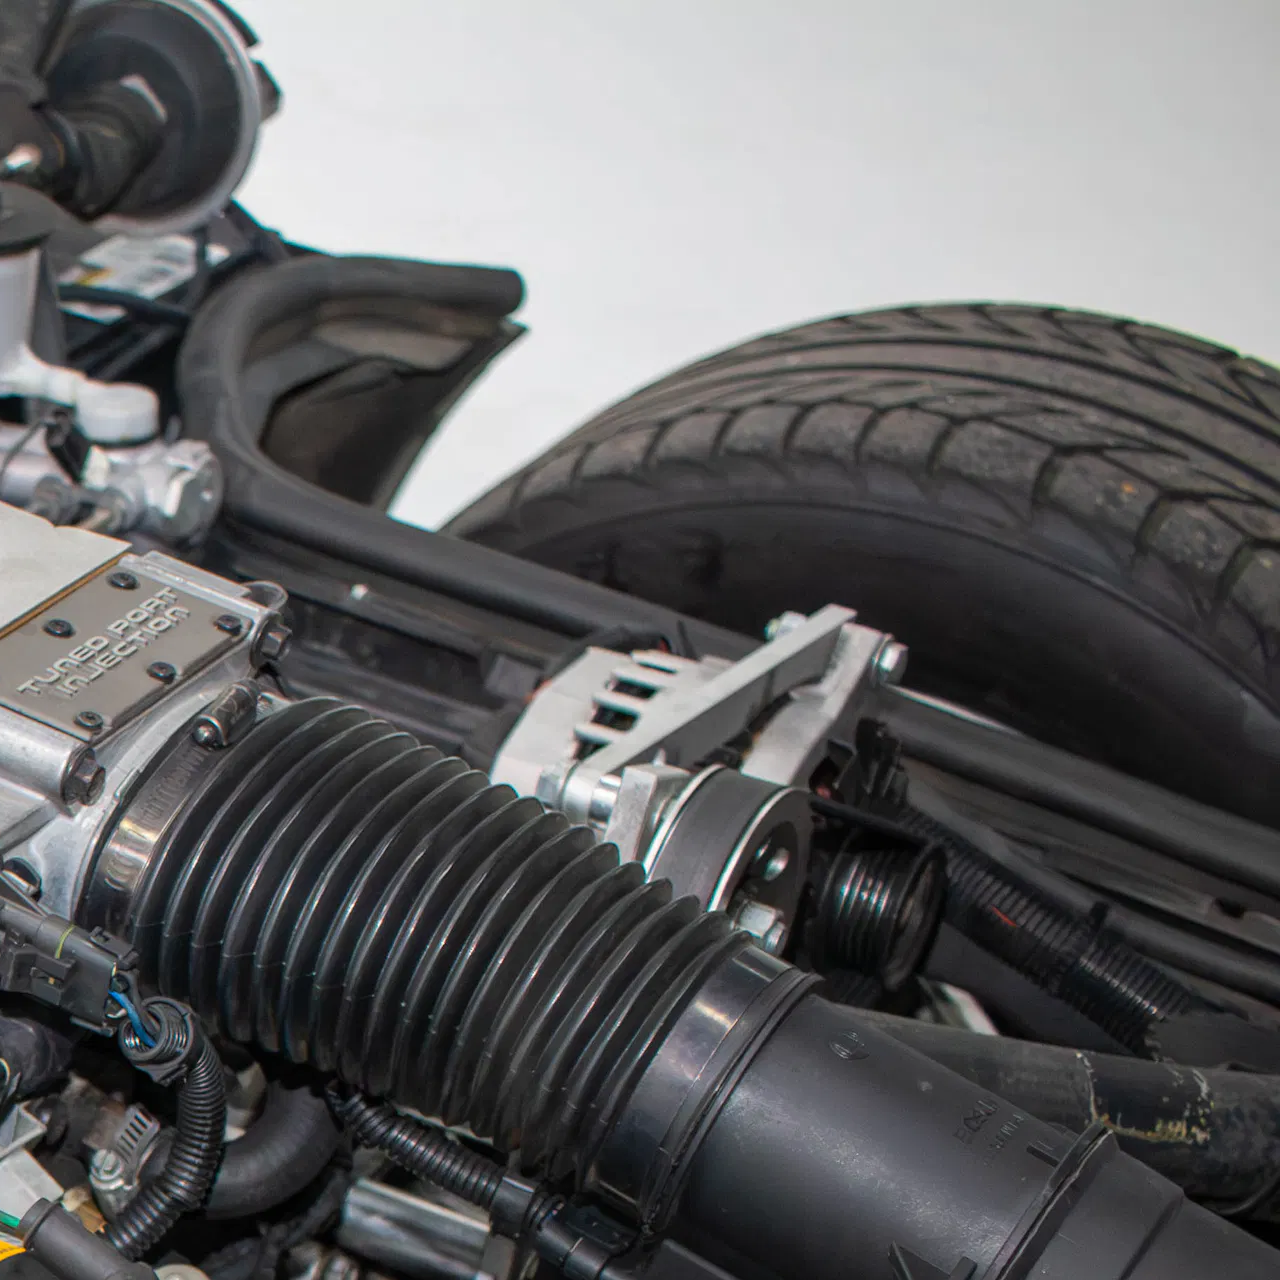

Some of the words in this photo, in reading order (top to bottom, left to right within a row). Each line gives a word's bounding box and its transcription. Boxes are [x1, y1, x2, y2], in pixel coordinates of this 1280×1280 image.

[16, 636, 110, 695] TUNED
[107, 587, 178, 637] PORT
[55, 606, 190, 697] INJECTION
